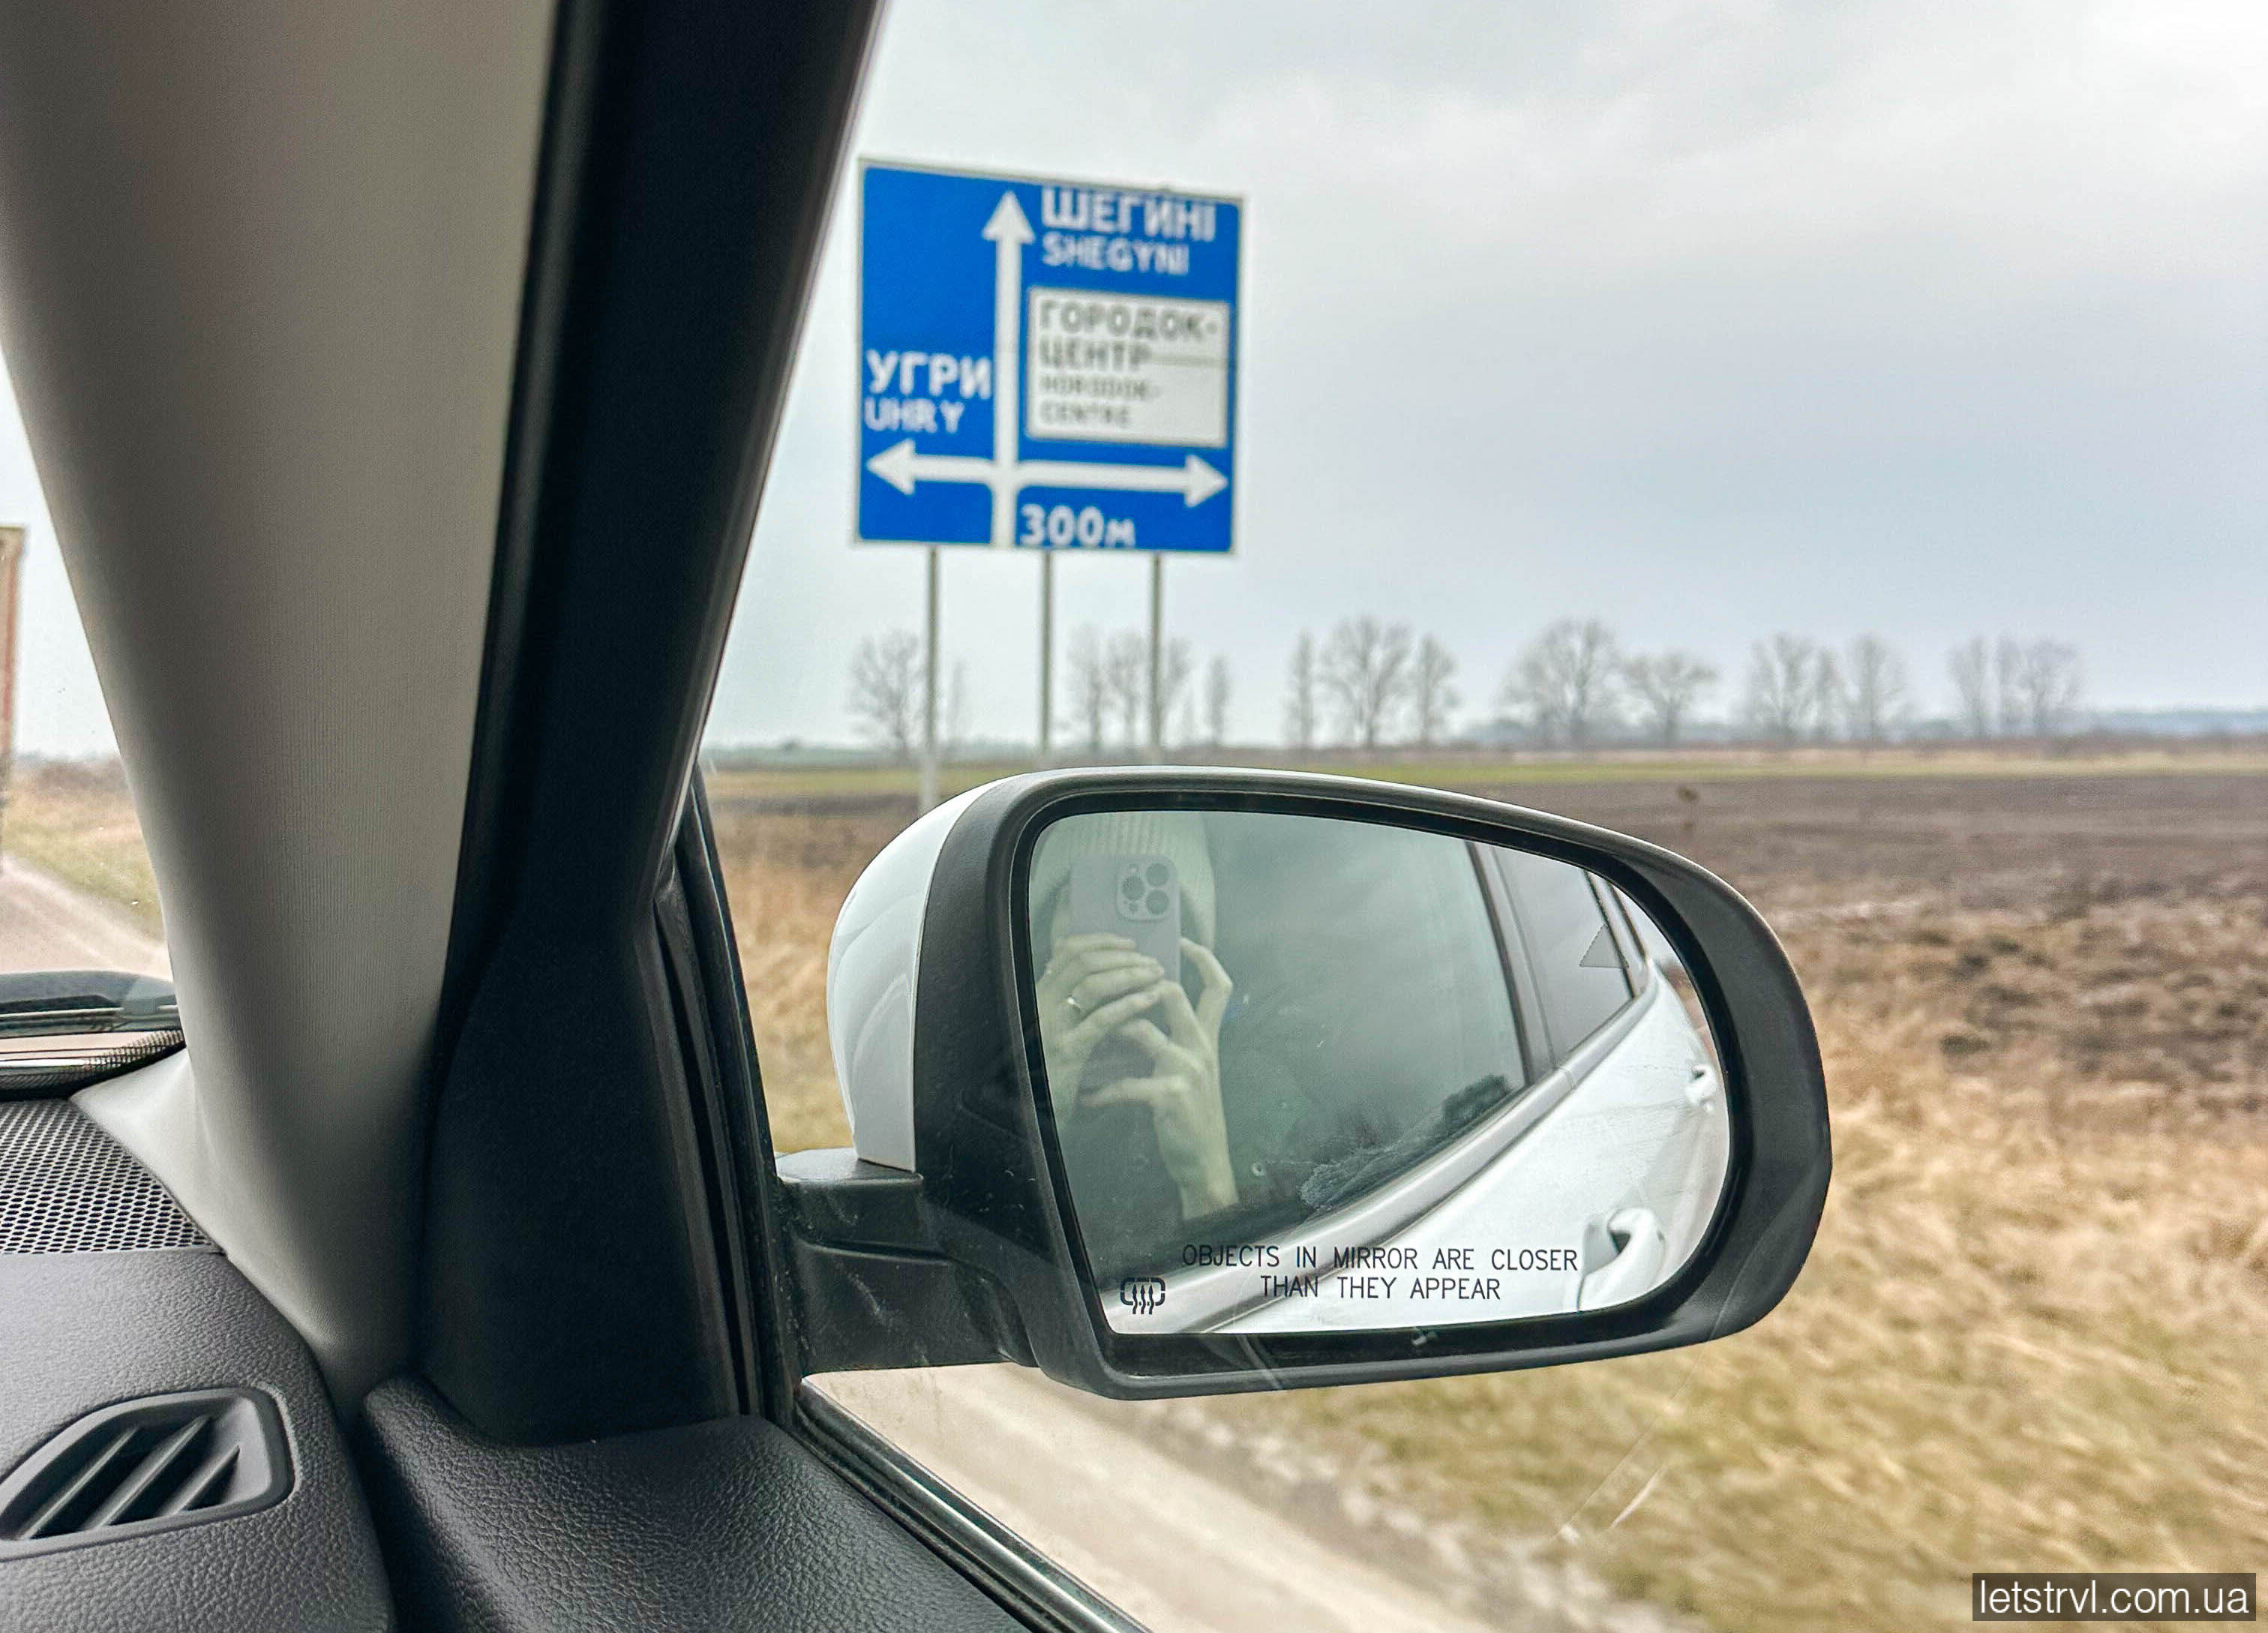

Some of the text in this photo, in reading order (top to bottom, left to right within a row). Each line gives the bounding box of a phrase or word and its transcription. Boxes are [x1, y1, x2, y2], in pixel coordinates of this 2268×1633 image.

[1041, 187, 1216, 242] ШЕГИНІ
[1042, 231, 1190, 275] SHEGYNI
[866, 349, 992, 400] УГРИ
[864, 395, 965, 434] UHRY
[1182, 1244, 1578, 1271] OBJECTS IN MIRROR ARE CLOSER
[1260, 1275, 1501, 1300] THAN THEY APPEAR
